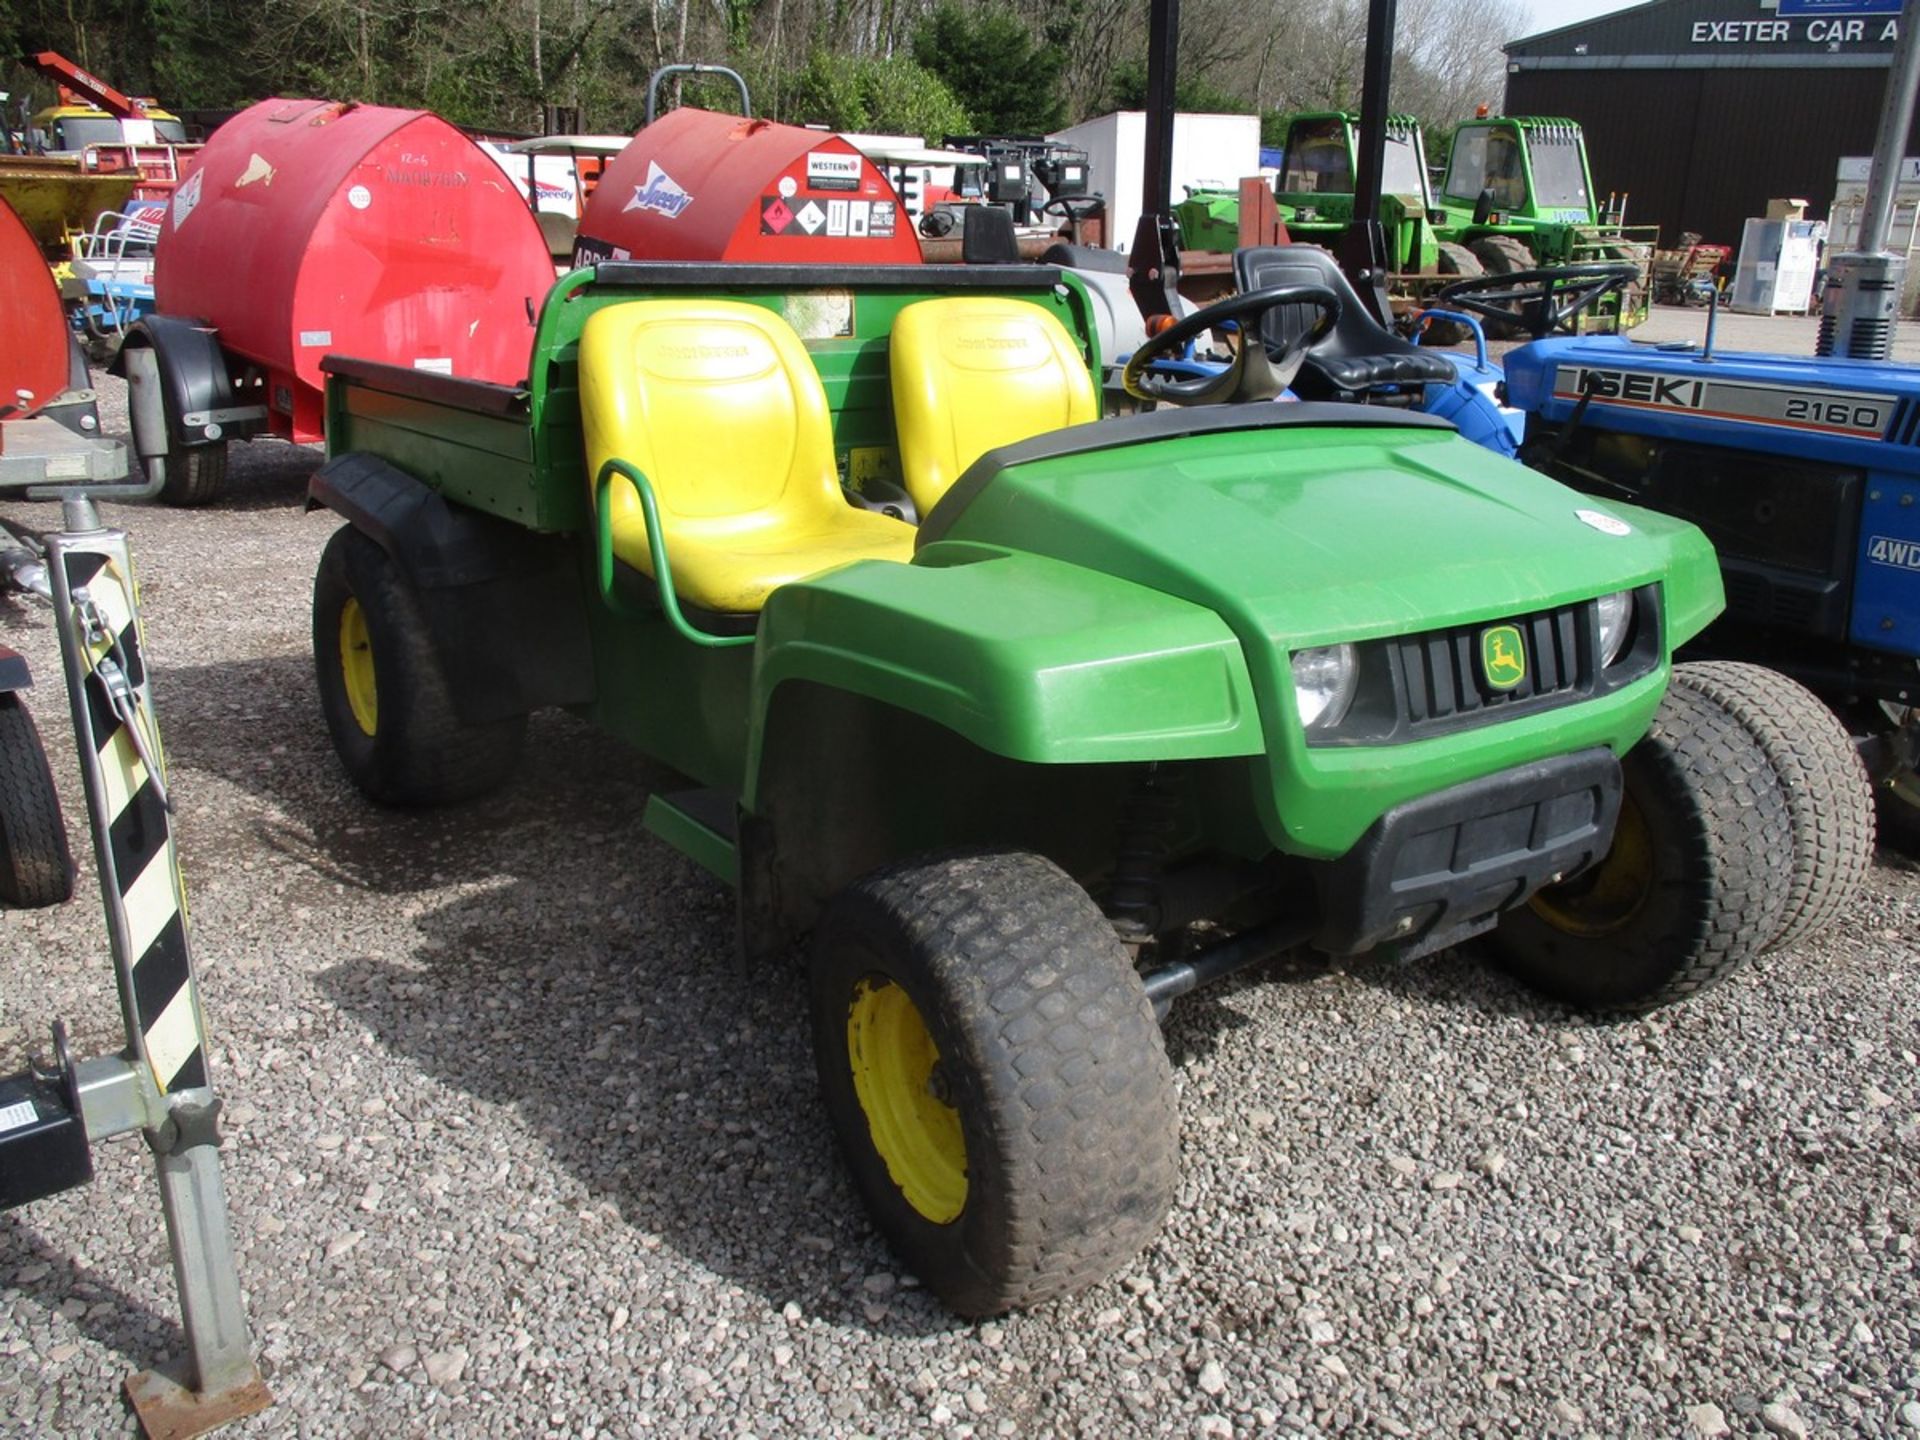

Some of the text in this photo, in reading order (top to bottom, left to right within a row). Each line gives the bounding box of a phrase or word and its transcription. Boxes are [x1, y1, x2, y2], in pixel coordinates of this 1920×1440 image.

[1691, 21, 1789, 42] EXETER
[1806, 20, 1864, 42] CAR
[811, 161, 849, 171] WESTERN
[637, 174, 691, 216] Speedy
[1577, 369, 1879, 428] ISEKI 2160
[1871, 540, 1920, 567] 4WD
